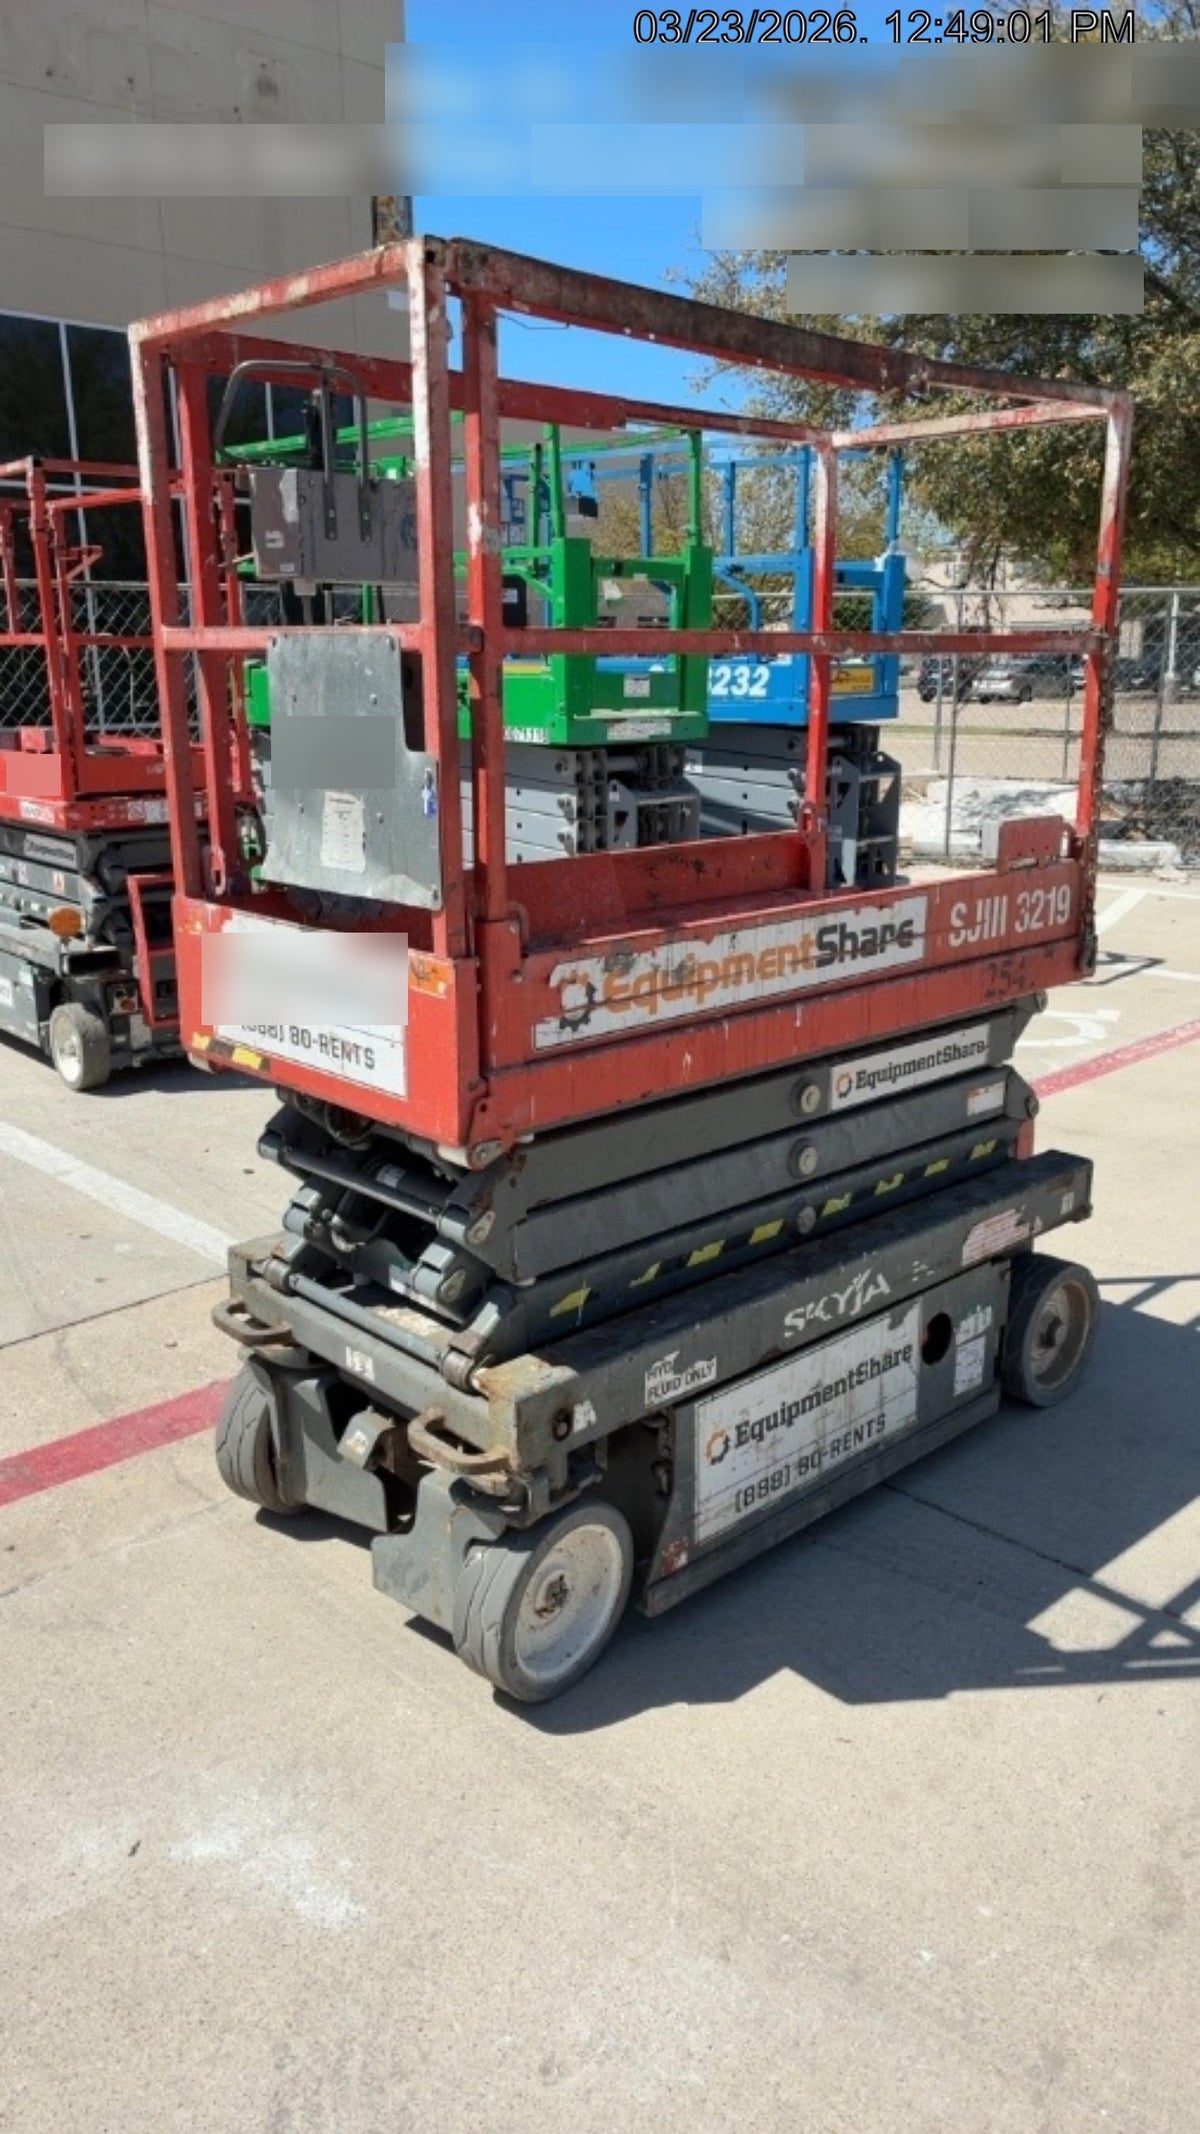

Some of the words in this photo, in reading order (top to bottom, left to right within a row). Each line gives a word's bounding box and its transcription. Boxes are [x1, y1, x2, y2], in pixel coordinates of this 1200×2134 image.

[709, 664, 770, 696] 232
[1014, 884, 1071, 934] 3219
[602, 919, 914, 1015] EquipmentShare
[289, 1025, 376, 1070] 80-RENTS
[734, 1344, 913, 1449] EquipmentShare
[734, 1464, 790, 1514] (888)
[797, 1412, 886, 1476] 80-RENTS
